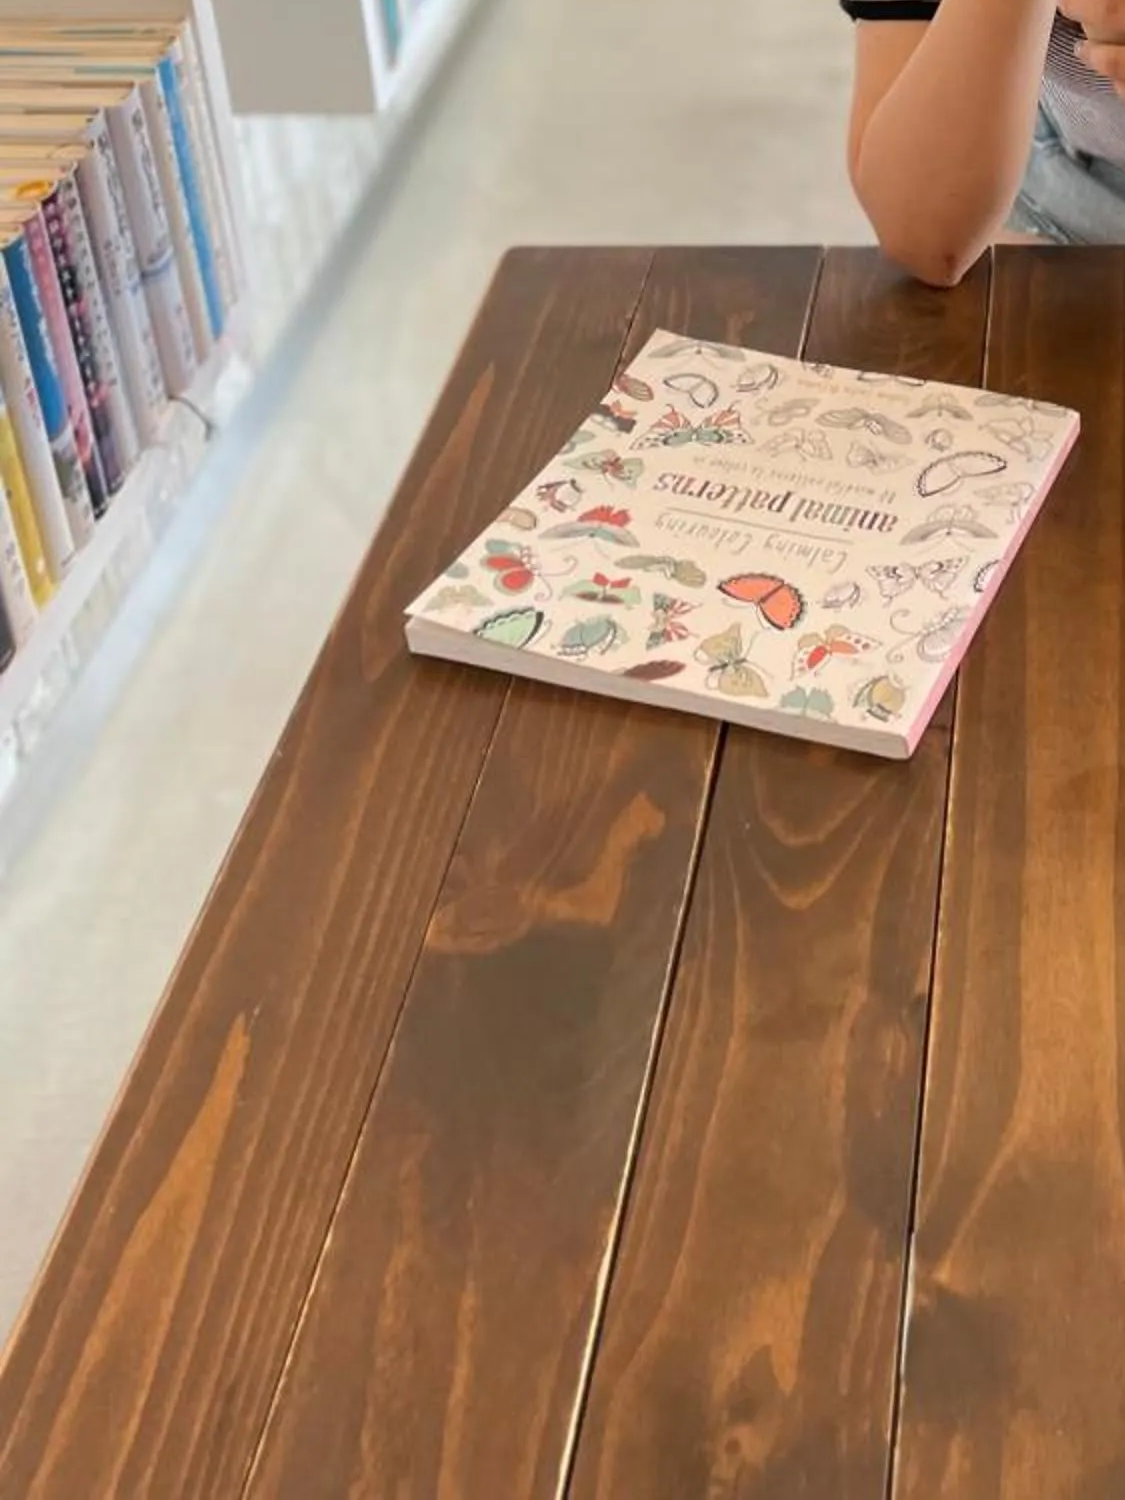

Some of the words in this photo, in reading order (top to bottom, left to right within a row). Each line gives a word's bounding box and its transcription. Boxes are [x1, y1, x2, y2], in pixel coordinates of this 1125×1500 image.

[651, 470, 792, 515] patterns
[653, 512, 753, 556] Colouring
[788, 498, 899, 535] animal
[763, 532, 848, 575] Calming
